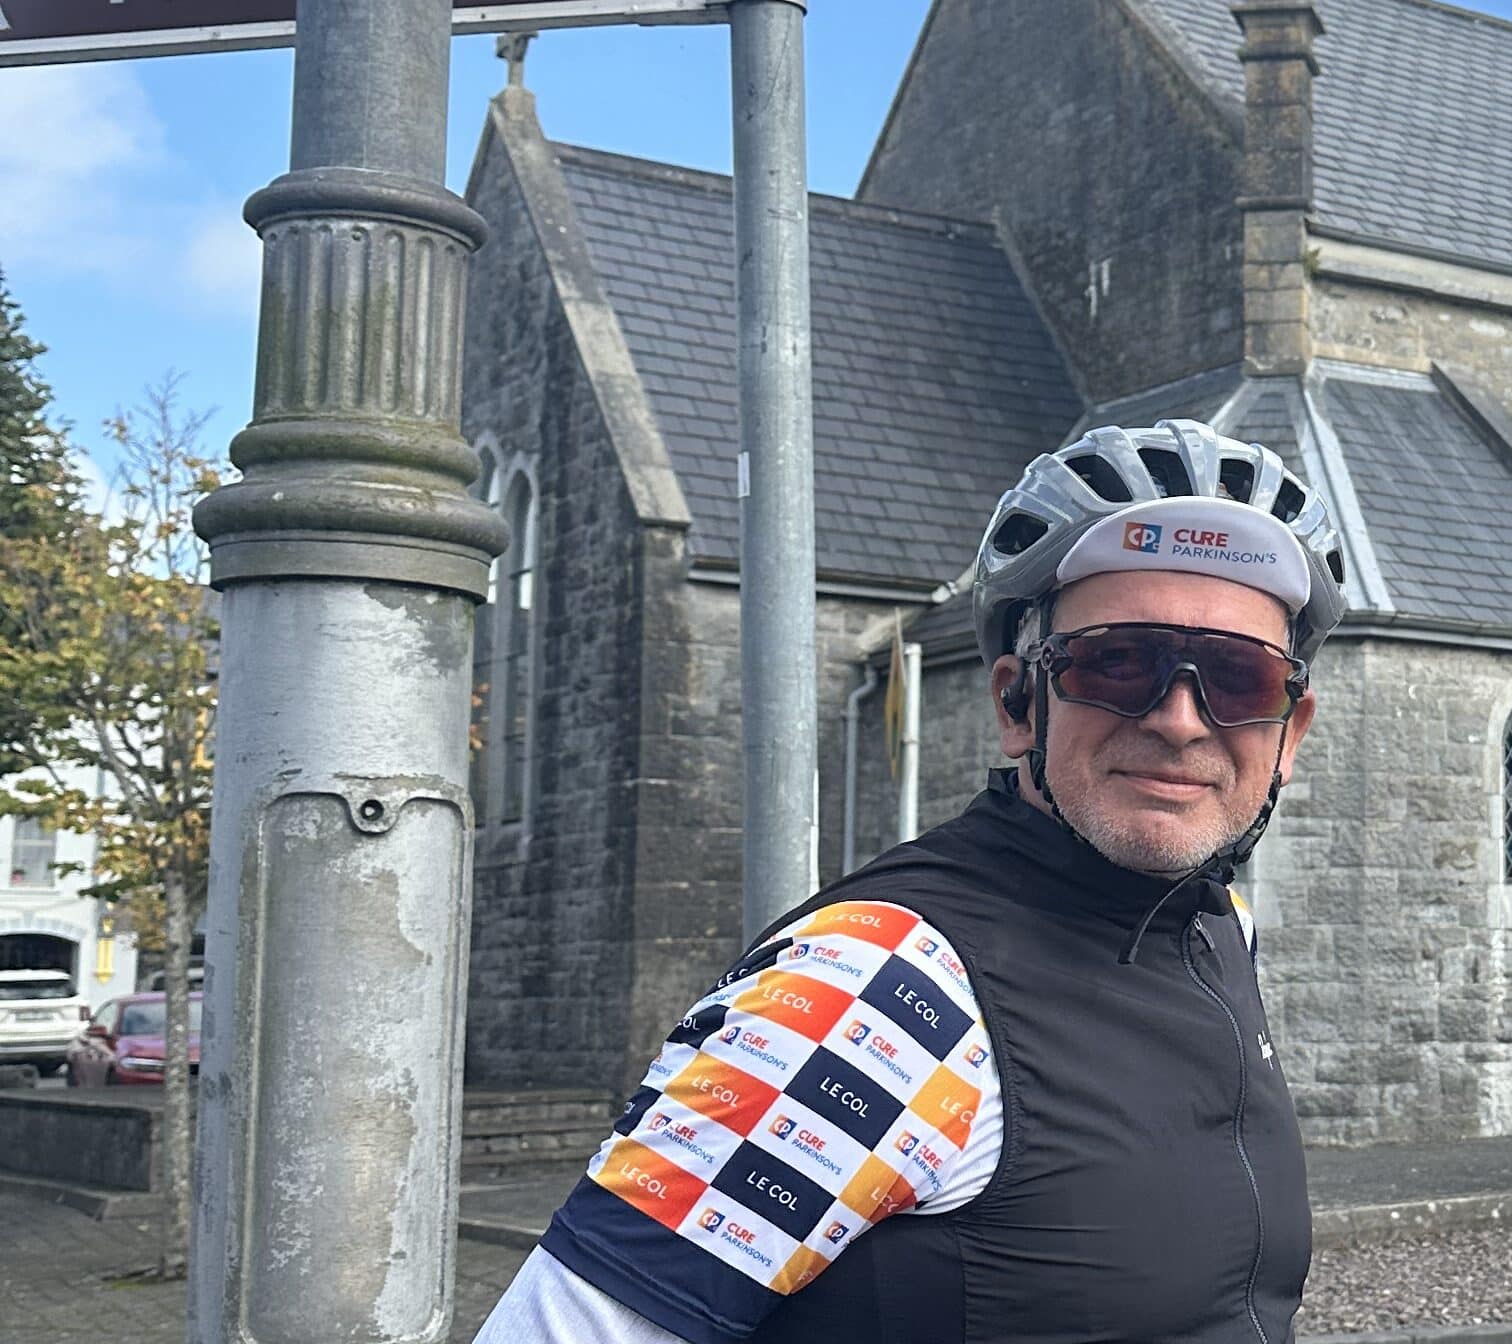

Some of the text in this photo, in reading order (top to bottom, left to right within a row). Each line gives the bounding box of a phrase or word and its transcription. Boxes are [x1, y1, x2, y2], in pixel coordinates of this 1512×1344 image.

[1173, 528, 1230, 548] CURE
[1171, 544, 1278, 564] PARKINSON'S
[849, 913, 882, 928] COL
[813, 945, 843, 960] CURE
[941, 952, 966, 977] CURE
[761, 985, 814, 1015] LE COL
[894, 983, 943, 1030] LE COL
[742, 1031, 770, 1050] CURE
[871, 1035, 898, 1059] CURE
[865, 1044, 913, 1085] PARKINSON'S
[691, 1074, 742, 1109] LE COL
[819, 1076, 872, 1118] LE COL
[940, 1096, 960, 1116] LE
[661, 1126, 714, 1165] PARKINSON'S
[798, 1128, 827, 1152] CURE
[791, 1138, 843, 1176] PARKINSON'S
[620, 1162, 669, 1200] LE COL
[746, 1170, 800, 1211] LE COL
[727, 1222, 756, 1245] CURE
[720, 1231, 773, 1268] PARKINSON'S
